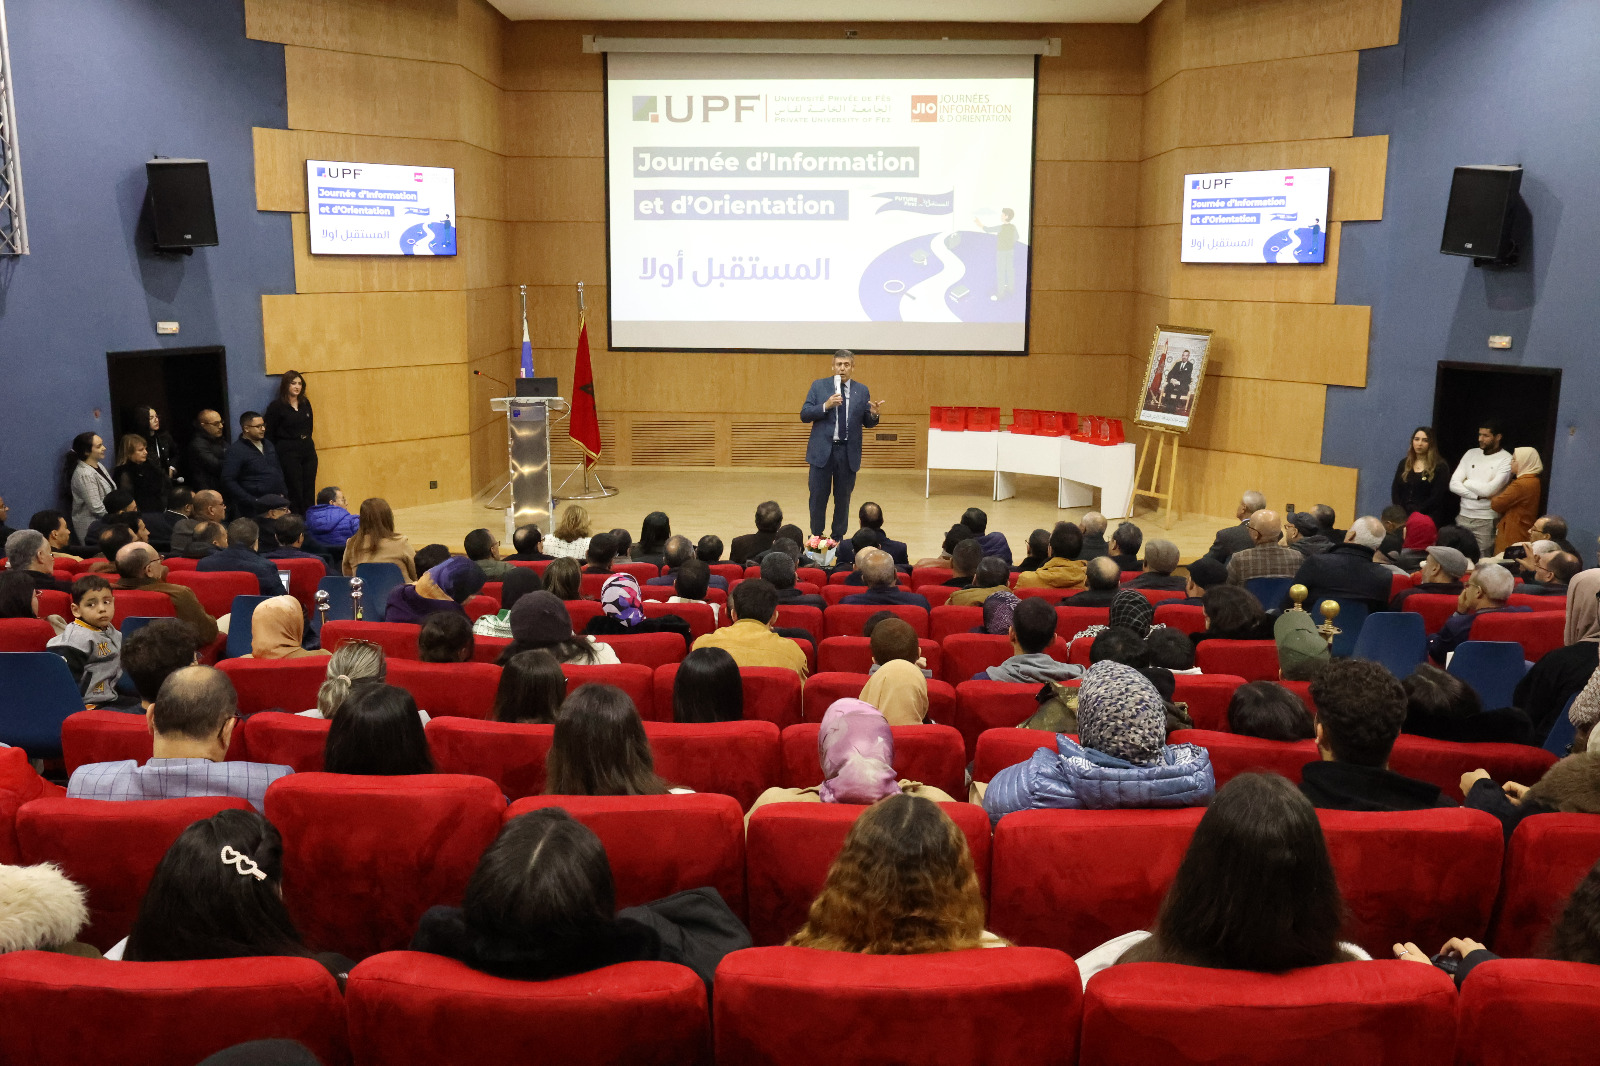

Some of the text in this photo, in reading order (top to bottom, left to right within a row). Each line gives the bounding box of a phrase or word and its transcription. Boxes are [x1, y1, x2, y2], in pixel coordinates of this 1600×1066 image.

[939, 93, 990, 104] JOURNÉES
[665, 94, 760, 123] UPF
[912, 102, 937, 115] JIO
[939, 104, 1012, 114] INFORMATION
[637, 150, 915, 172] Journée d'Information
[328, 167, 363, 180] UPF
[1202, 178, 1234, 190] UPF
[318, 188, 417, 201] Journée d'Information
[638, 193, 836, 215] et d'Orientation
[1191, 196, 1286, 208] Journée d'Information
[319, 204, 391, 216] et d'Orientation
[1201, 213, 1257, 224] d'Orientation
[340, 229, 390, 242] المستقبل
[638, 249, 831, 288] المستقبل أولا
